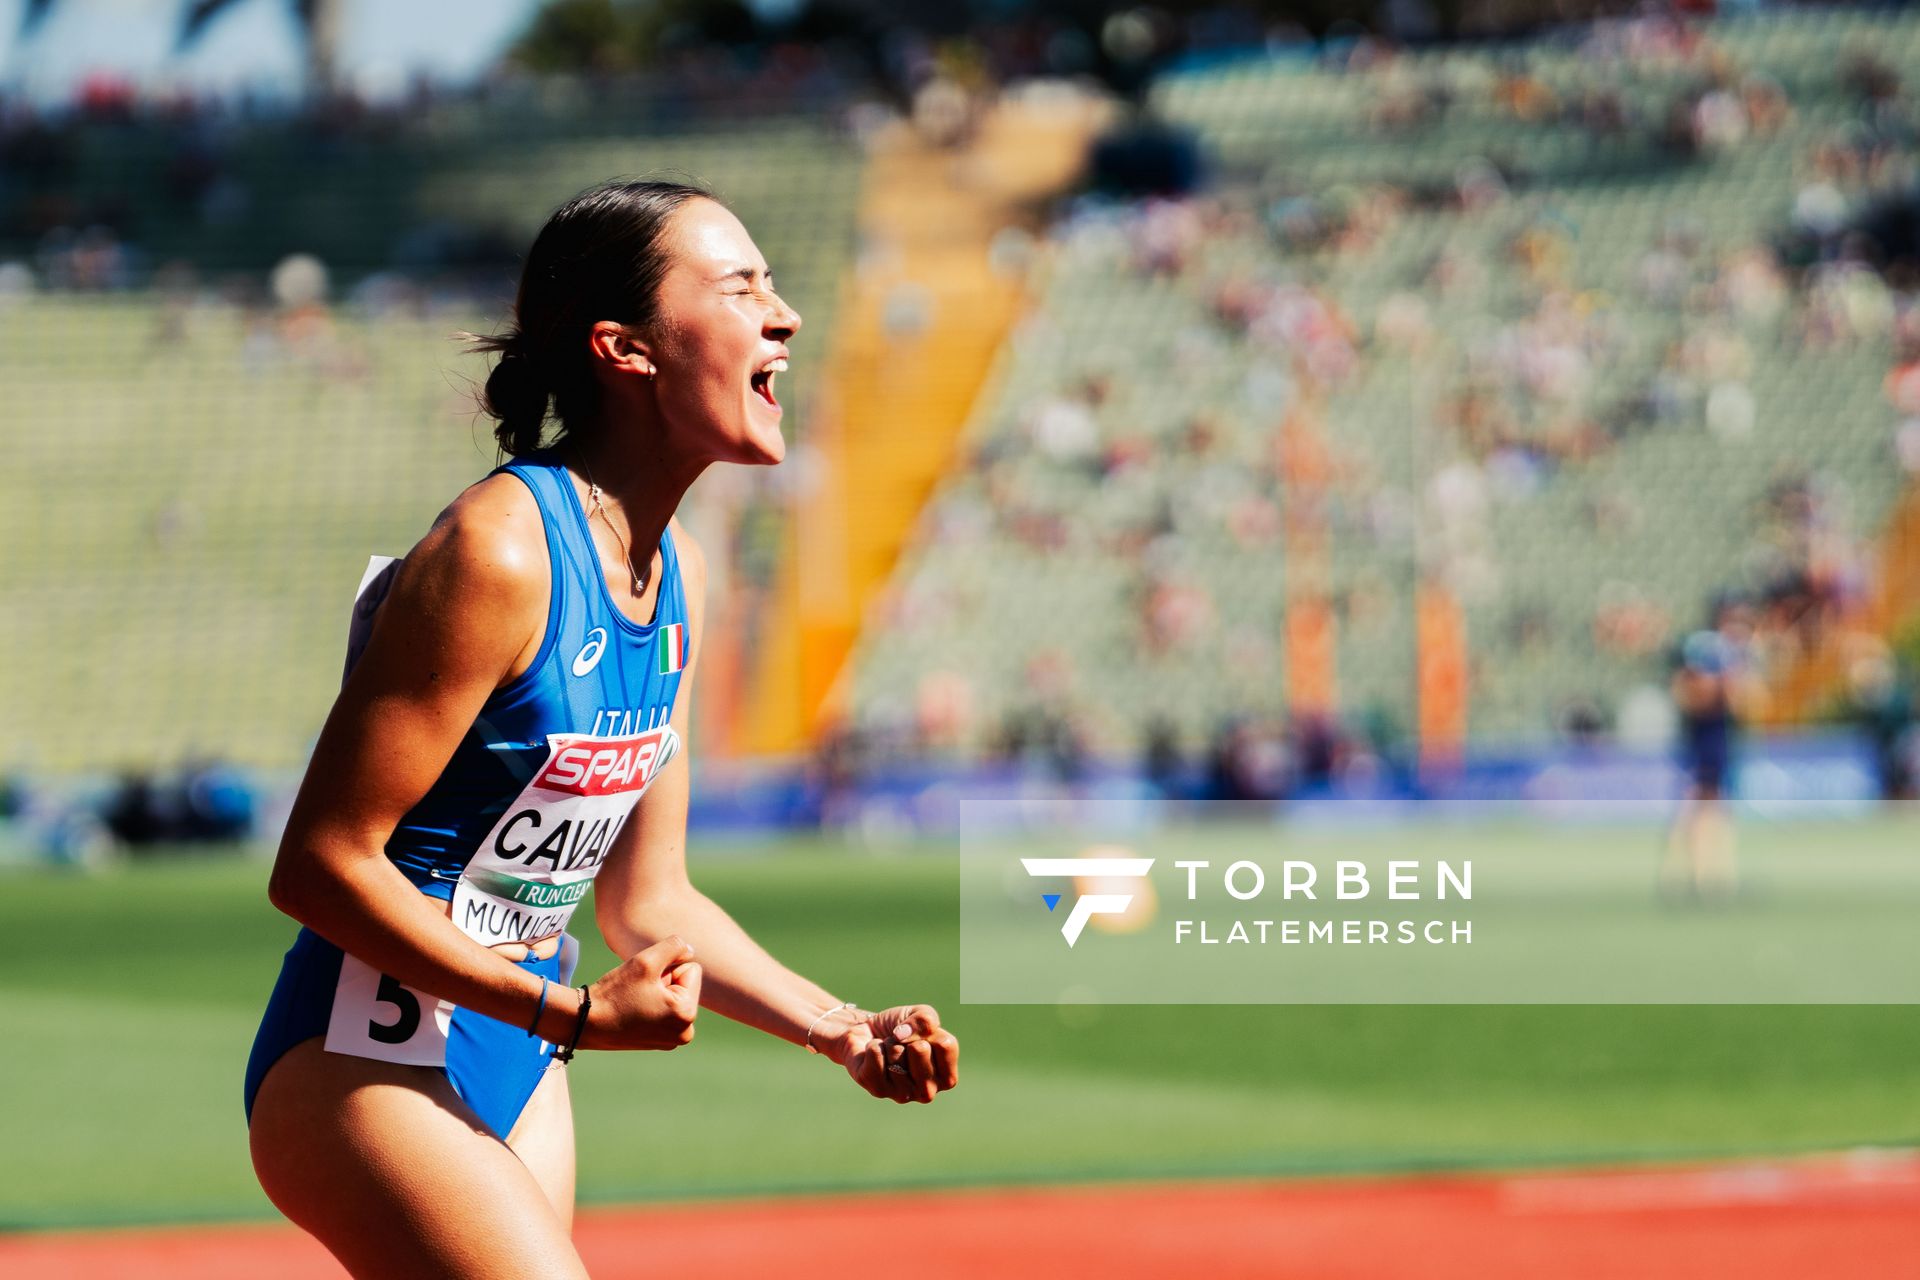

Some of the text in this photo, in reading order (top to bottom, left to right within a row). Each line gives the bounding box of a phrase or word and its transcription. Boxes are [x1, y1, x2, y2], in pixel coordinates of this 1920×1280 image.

[545, 742, 657, 788] SPAR
[514, 883, 526, 899] I
[525, 885, 563, 905] RUN
[368, 973, 421, 1044] 5
